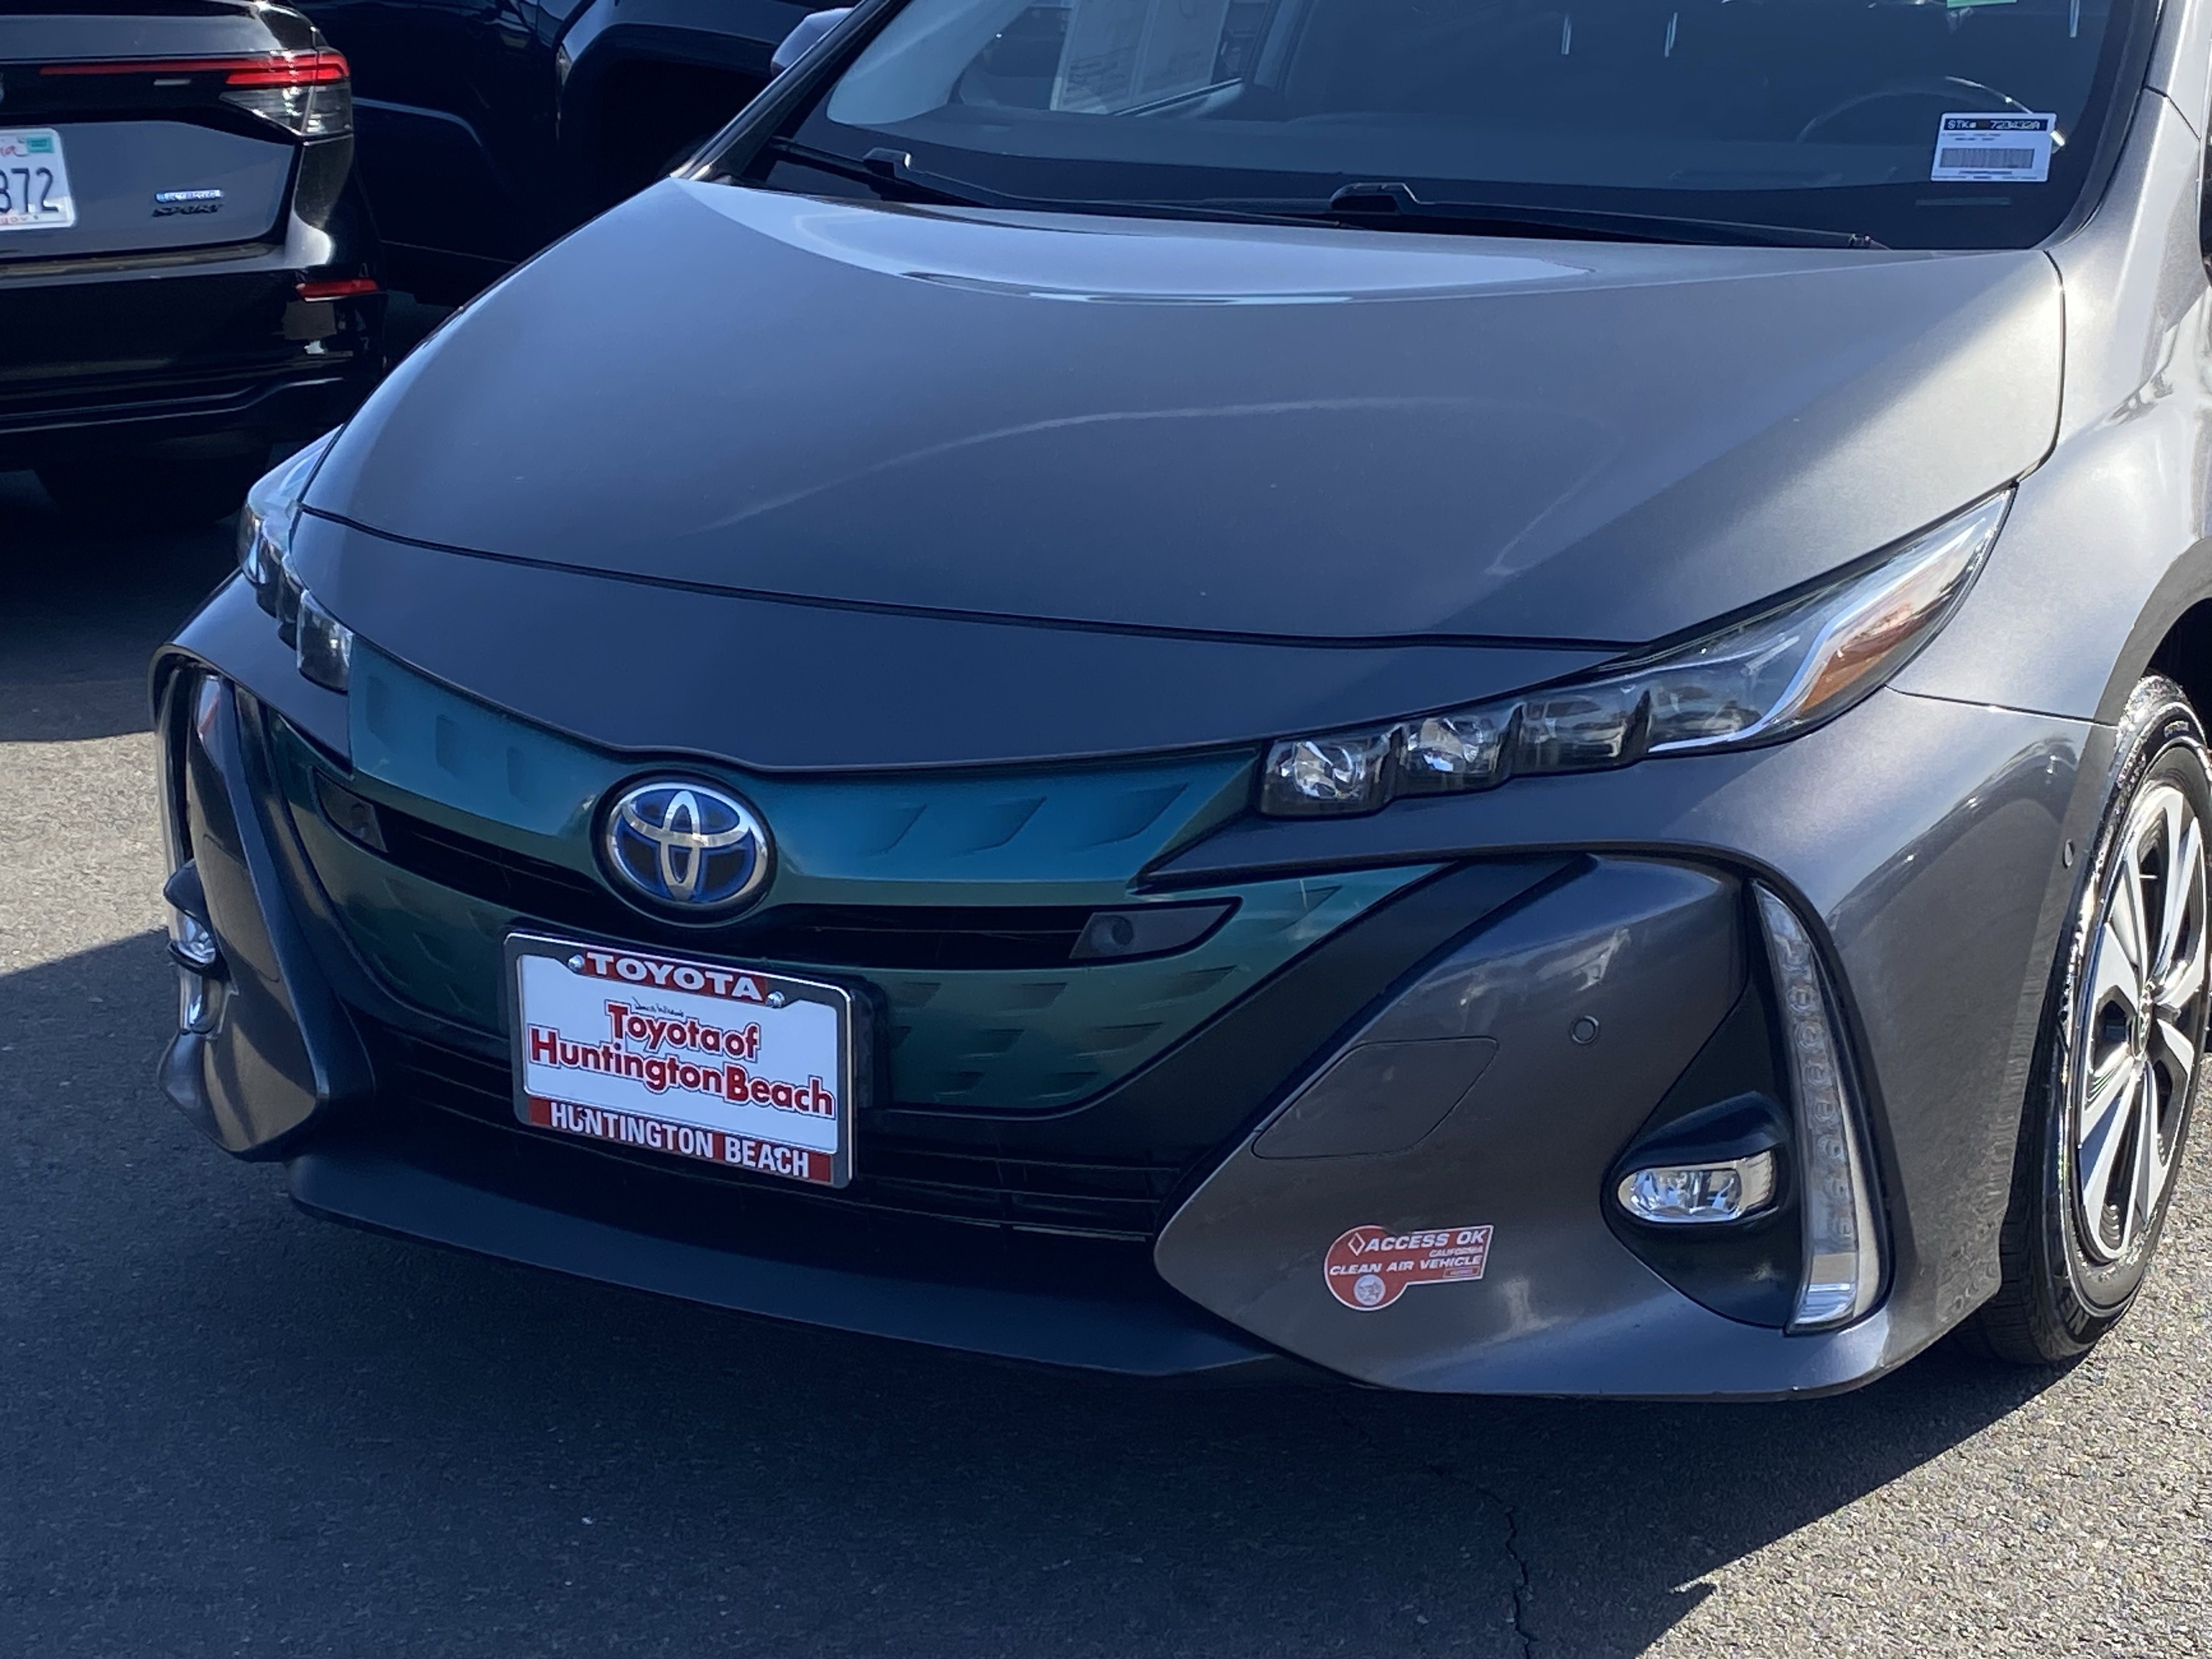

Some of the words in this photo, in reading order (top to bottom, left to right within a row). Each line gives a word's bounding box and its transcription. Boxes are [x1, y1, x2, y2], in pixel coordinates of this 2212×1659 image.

[586, 952, 763, 1001] TOYOTA
[605, 1000, 722, 1052] Toyota
[723, 1023, 760, 1063] of
[528, 1024, 724, 1094] Huntington
[724, 1063, 836, 1120] Beach
[551, 1102, 713, 1159] HUNTINGTON
[724, 1136, 809, 1178] BEACH
[1329, 1263, 1383, 1276] CLEAN
[1386, 1261, 1414, 1272] AIR
[1420, 1255, 1482, 1270] VEHICLE
[1364, 1234, 1449, 1252] ACCESS
[1457, 1229, 1487, 1244] OK
